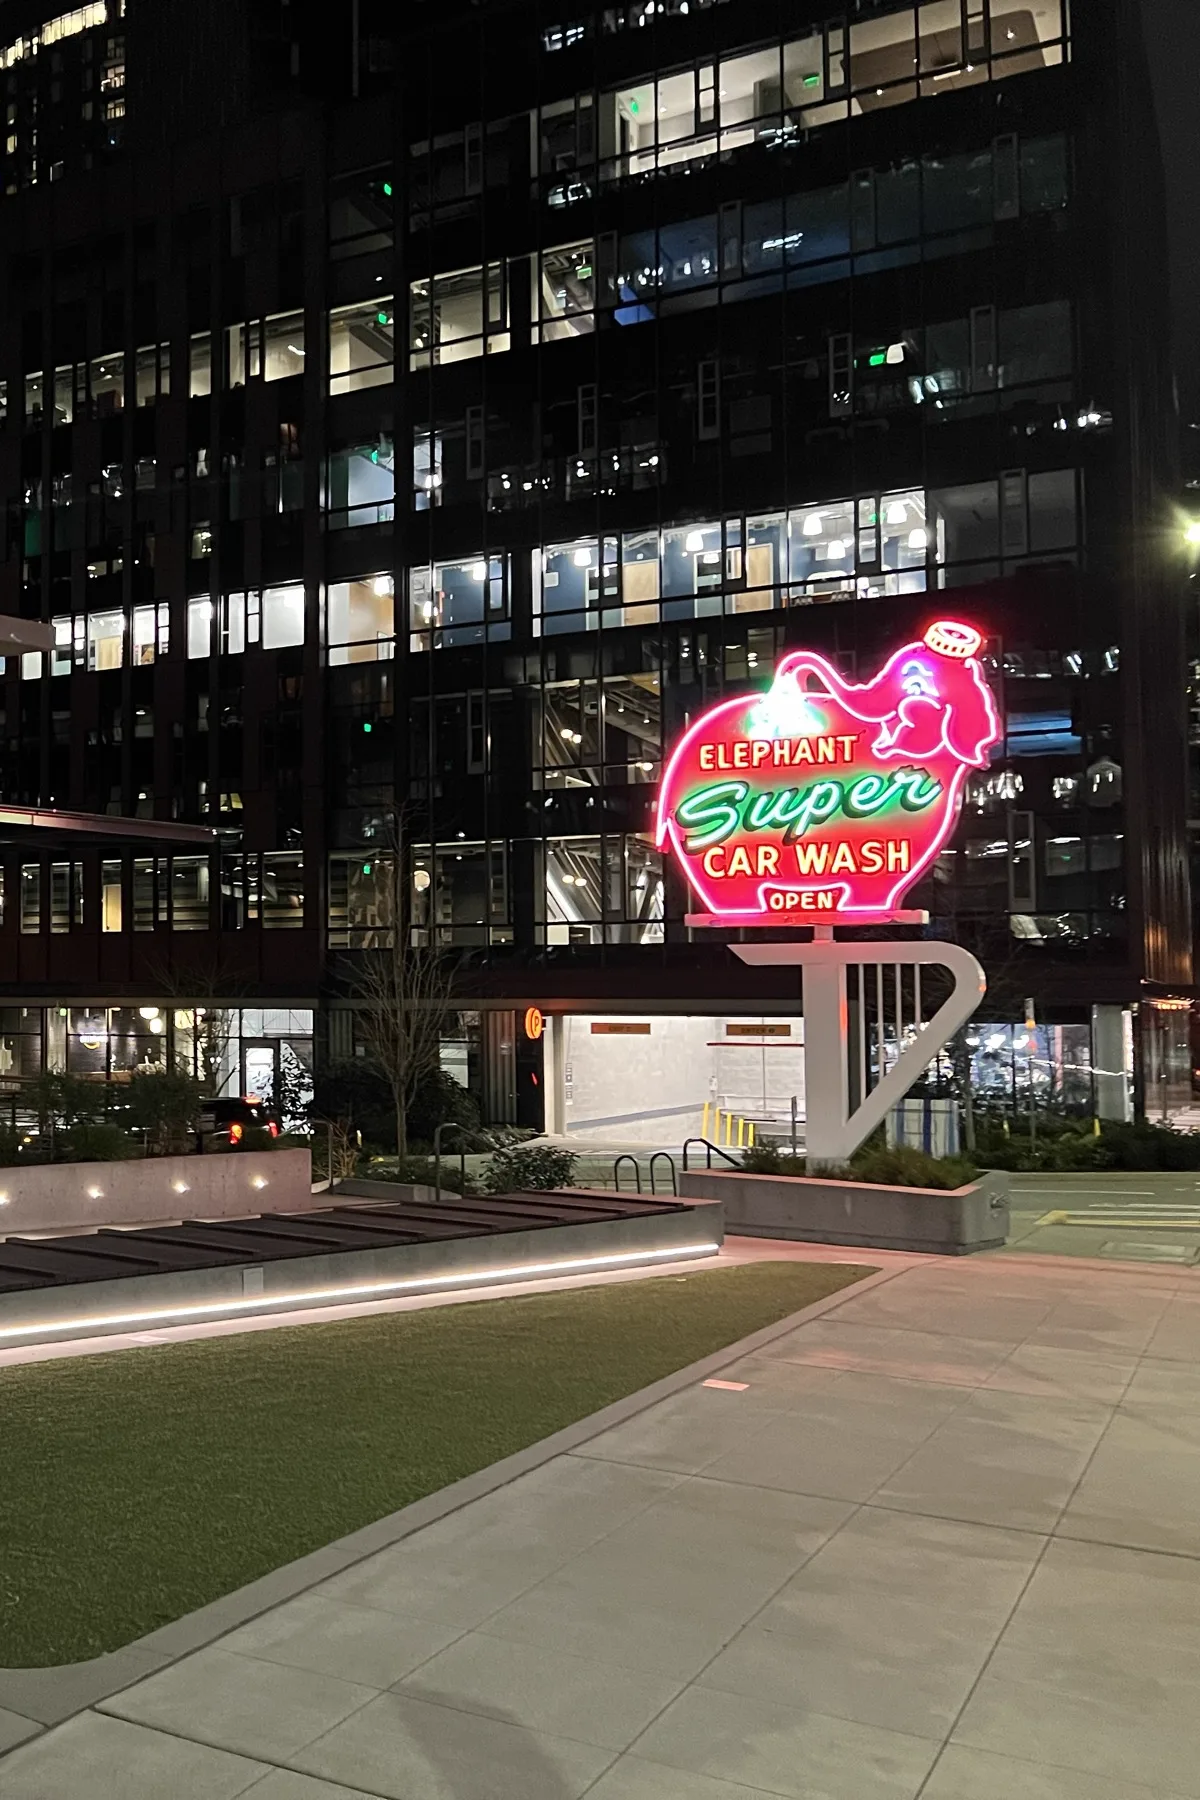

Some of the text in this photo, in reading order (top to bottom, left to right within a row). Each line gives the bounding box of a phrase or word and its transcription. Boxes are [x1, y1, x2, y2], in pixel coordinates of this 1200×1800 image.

[699, 735, 860, 770] ELEPHANT
[676, 766, 943, 854] Super
[703, 840, 911, 878] CAR WASH
[769, 891, 834, 911] OPEN
